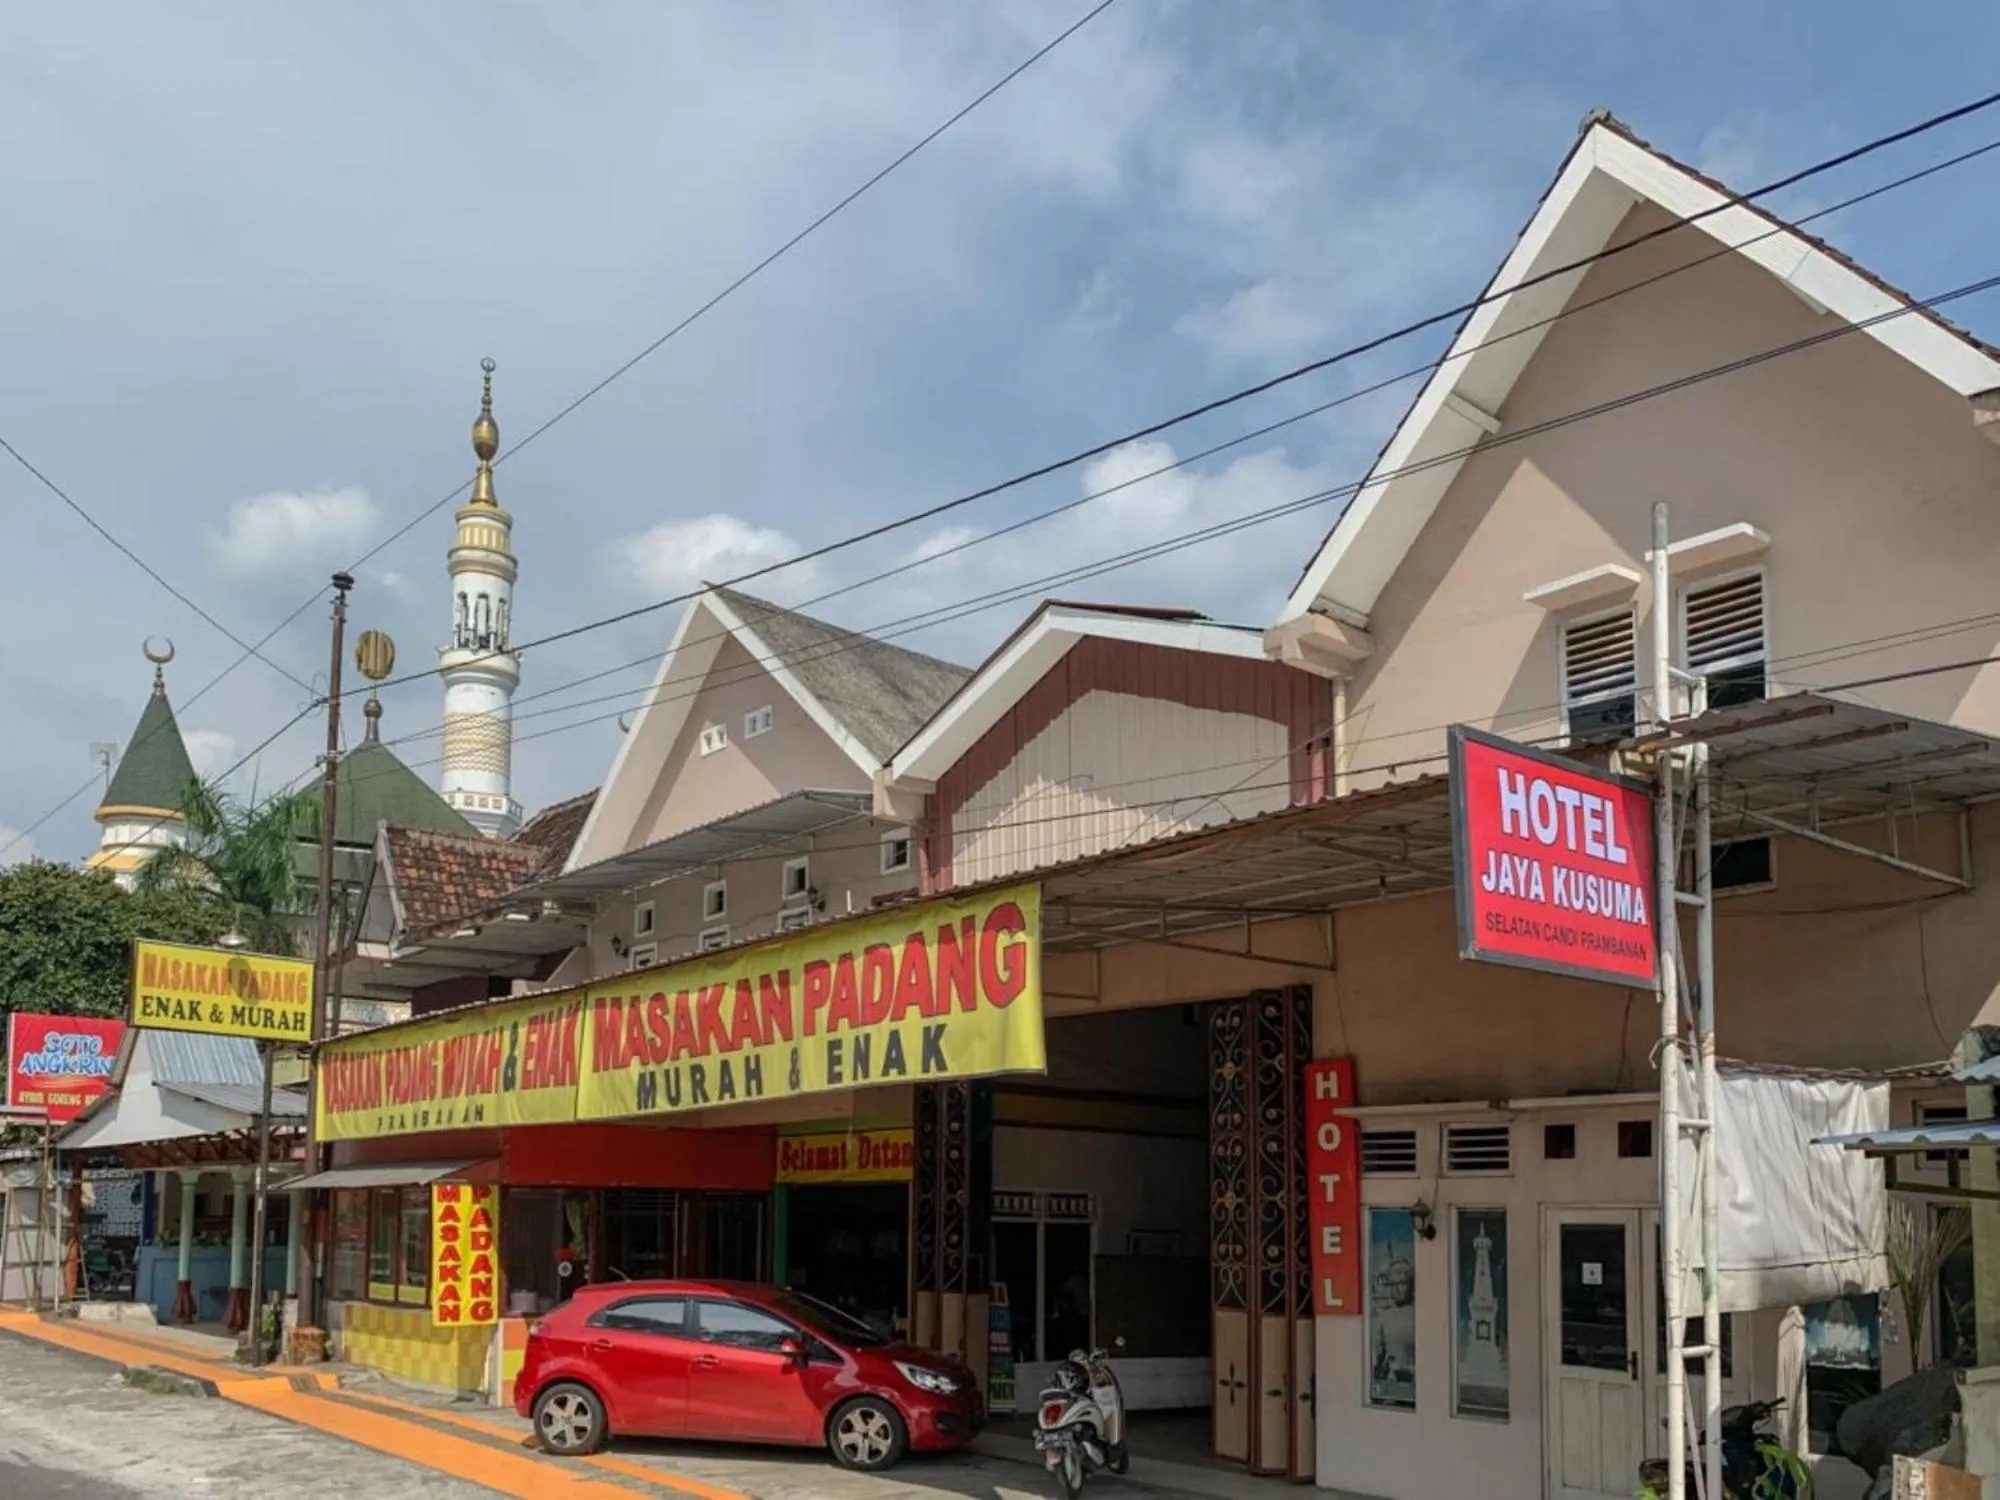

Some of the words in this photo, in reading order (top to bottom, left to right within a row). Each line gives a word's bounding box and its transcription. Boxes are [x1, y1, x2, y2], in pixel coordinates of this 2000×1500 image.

[1499, 768, 1628, 865] HOTEL
[1482, 850, 1546, 902] JAYA
[1552, 865, 1648, 927] KUSUMA
[1485, 911, 1541, 940] SELATAN
[141, 995, 203, 1022] ENAK
[209, 1003, 225, 1025] &
[231, 1005, 307, 1032] MURAH
[142, 952, 230, 997] MASAKAN
[239, 969, 308, 1004] PADANG
[593, 968, 794, 1073] MASAKAN
[803, 901, 1028, 1037] PADANG
[44, 1032, 103, 1056] SOTO
[503, 1020, 519, 1092] &
[520, 1002, 583, 1090] ENAK
[636, 1054, 764, 1111] MURAH
[788, 1047, 800, 1091] &
[827, 1023, 949, 1086] ENAK
[781, 1140, 847, 1172] Selamat
[1315, 1071, 1343, 1306] HOTEL
[437, 1184, 461, 1322] MASAKAN
[470, 1184, 493, 1322] PADANG
